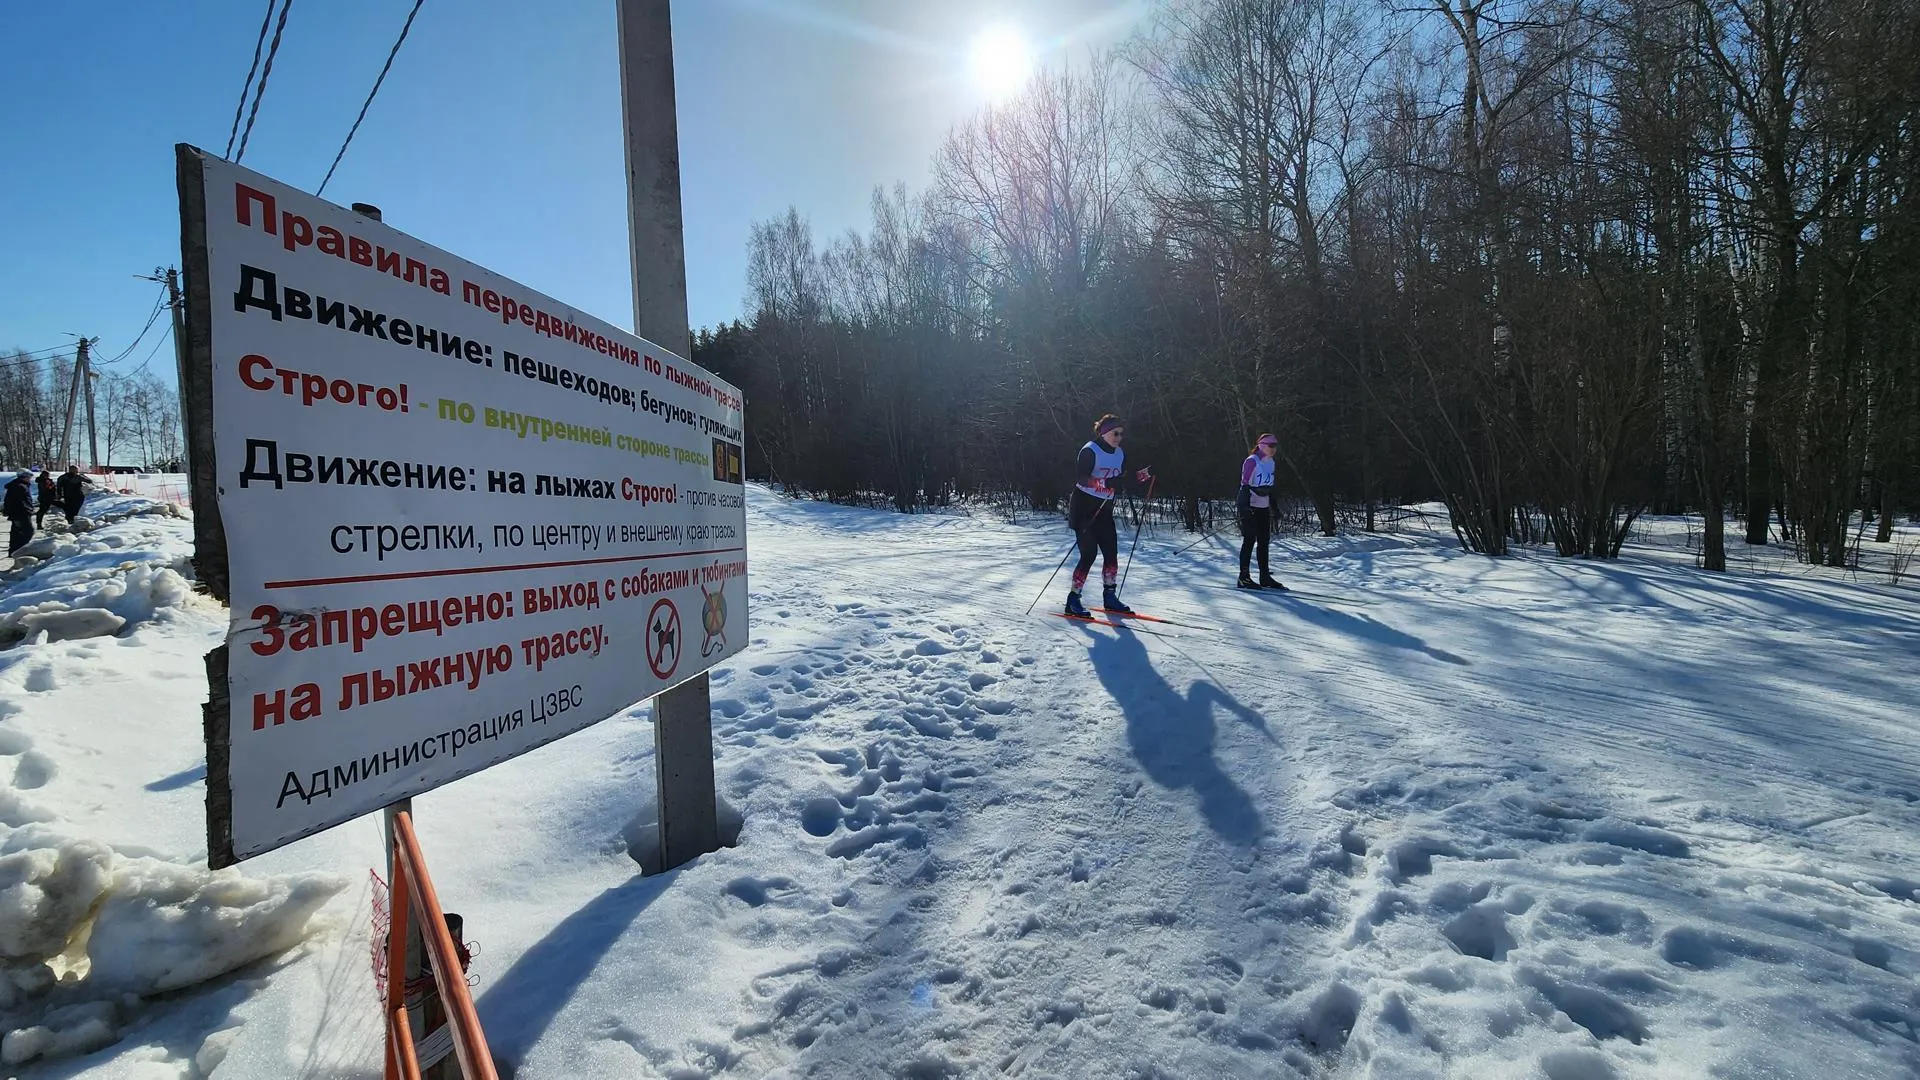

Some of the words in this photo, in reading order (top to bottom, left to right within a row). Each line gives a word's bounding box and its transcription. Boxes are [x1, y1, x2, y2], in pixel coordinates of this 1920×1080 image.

[236, 182, 450, 296] Правила
[463, 280, 639, 367] передвижения
[644, 355, 661, 376] по
[665, 366, 712, 398] лыжной
[234, 264, 493, 367] Движение:
[504, 351, 636, 412] пешеходов;
[640, 390, 697, 430] бегунов;
[700, 415, 742, 442] гуляющих
[238, 354, 409, 413] Строго!
[438, 398, 475, 423] по
[485, 406, 612, 447] внутренней
[617, 433, 670, 458] стороне
[673, 447, 709, 465] трассы
[239, 438, 476, 491] Движение:
[487, 470, 526, 494] на
[535, 474, 616, 500] лыжах
[621, 477, 677, 507] Строго!
[687, 490, 717, 510] против
[330, 524, 483, 561] стрелки,
[494, 525, 524, 548] по
[532, 524, 601, 550] центру
[607, 525, 616, 543] и
[621, 525, 683, 545] внешнему
[687, 525, 709, 544] краю
[250, 591, 514, 656] Запрещено:
[523, 579, 600, 615] выход
[604, 579, 616, 601] с
[621, 567, 689, 598] собаками
[693, 568, 699, 585] и
[701, 559, 746, 581] тюбингами
[253, 682, 321, 731] на
[339, 644, 513, 710] лыжную
[521, 623, 609, 671] трассу.
[276, 708, 523, 809] Администрация
[530, 685, 583, 725] ЦЗВС
